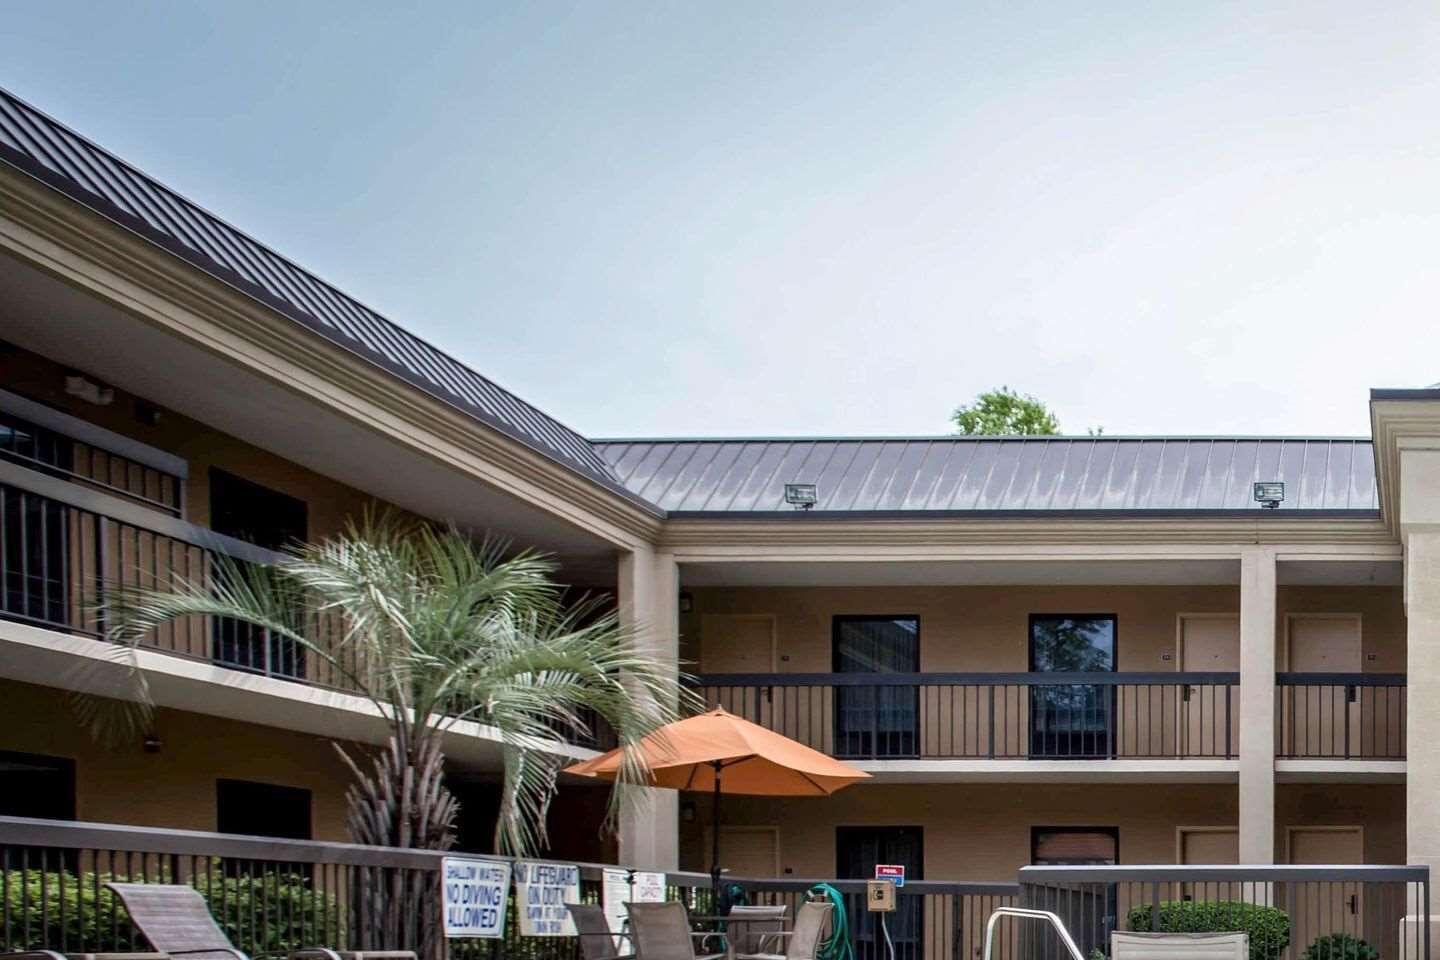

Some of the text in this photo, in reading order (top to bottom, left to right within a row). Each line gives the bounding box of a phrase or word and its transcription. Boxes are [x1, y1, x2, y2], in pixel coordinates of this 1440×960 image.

[447, 866, 505, 882] SHALLOW WATER
[514, 863, 577, 887] NO LIFEGUARD
[446, 884, 501, 906] NO DIVING
[528, 886, 567, 905] ON DUTY
[447, 907, 497, 929] ALLOWED
